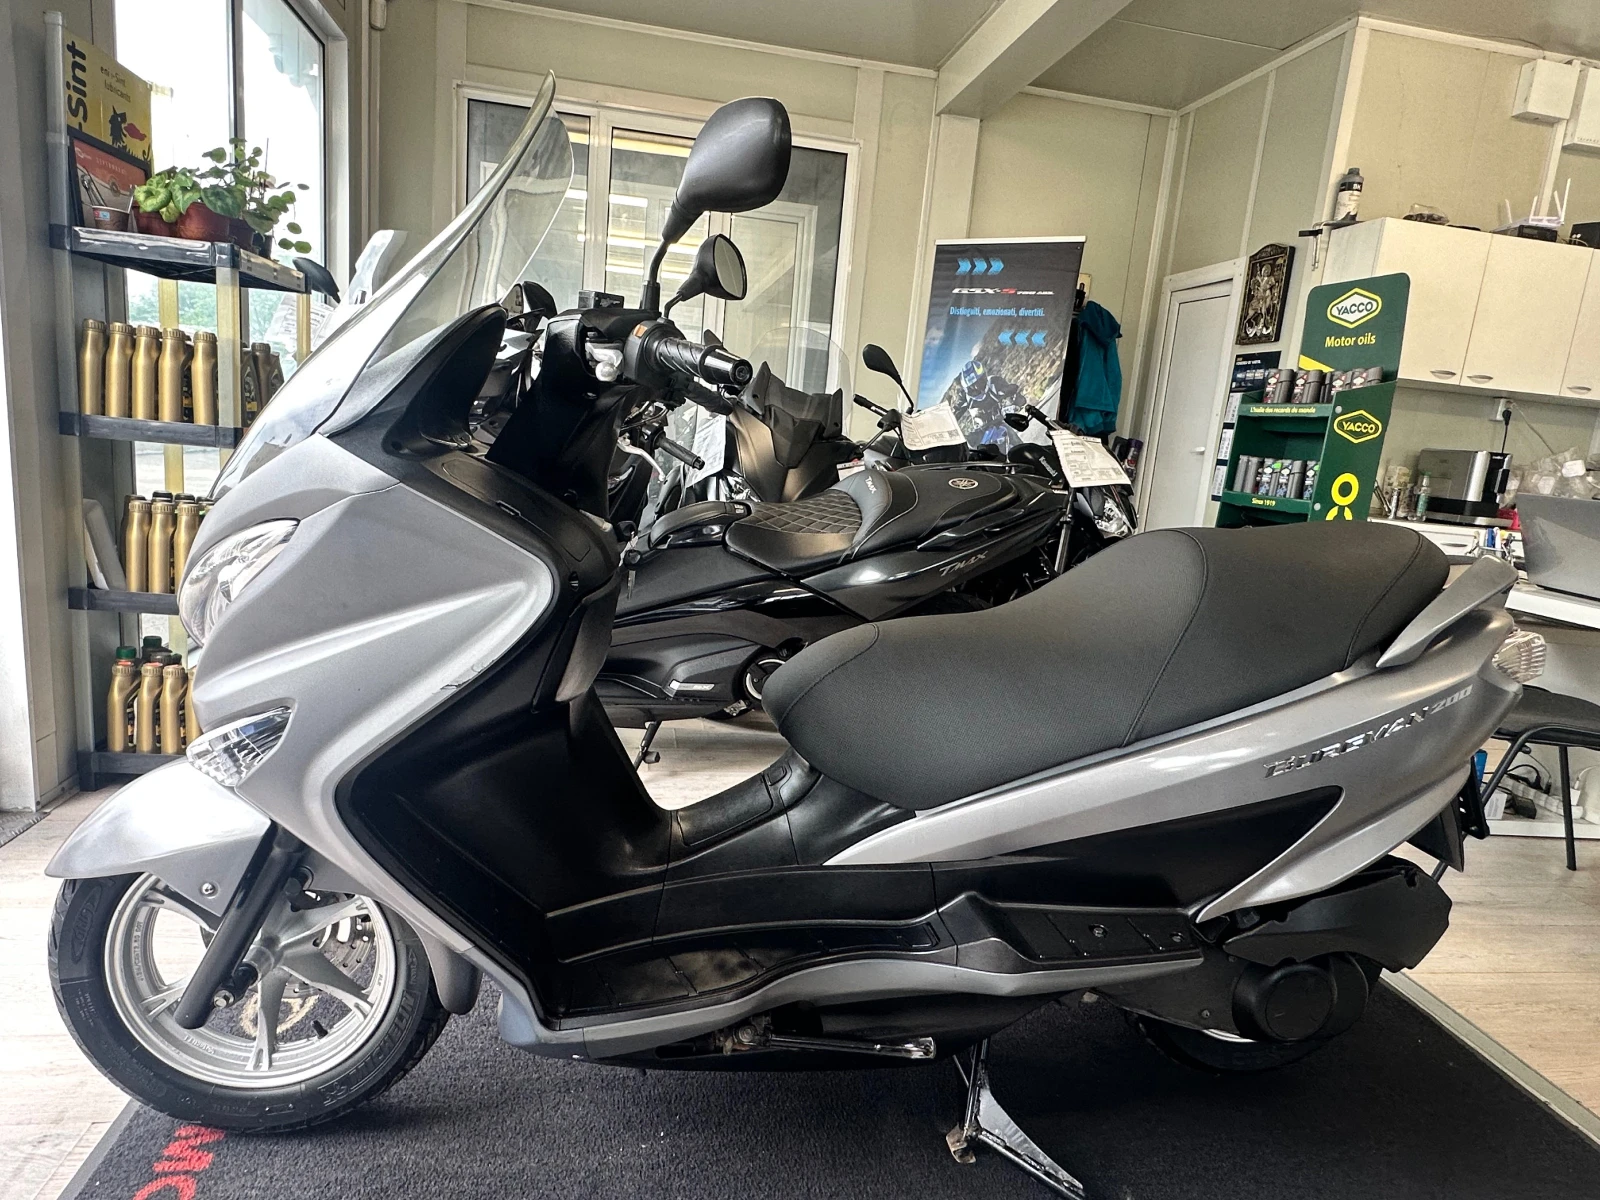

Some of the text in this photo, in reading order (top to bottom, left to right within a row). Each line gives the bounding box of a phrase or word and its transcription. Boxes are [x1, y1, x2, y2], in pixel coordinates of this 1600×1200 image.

[950, 306, 1045, 317] Distinguiti, emozionati, divertiti.
[1336, 301, 1373, 315] YACCO
[1325, 332, 1376, 348] Motor oils
[1342, 421, 1376, 434] YACCO
[1264, 684, 1473, 778] BURGMAN 200
